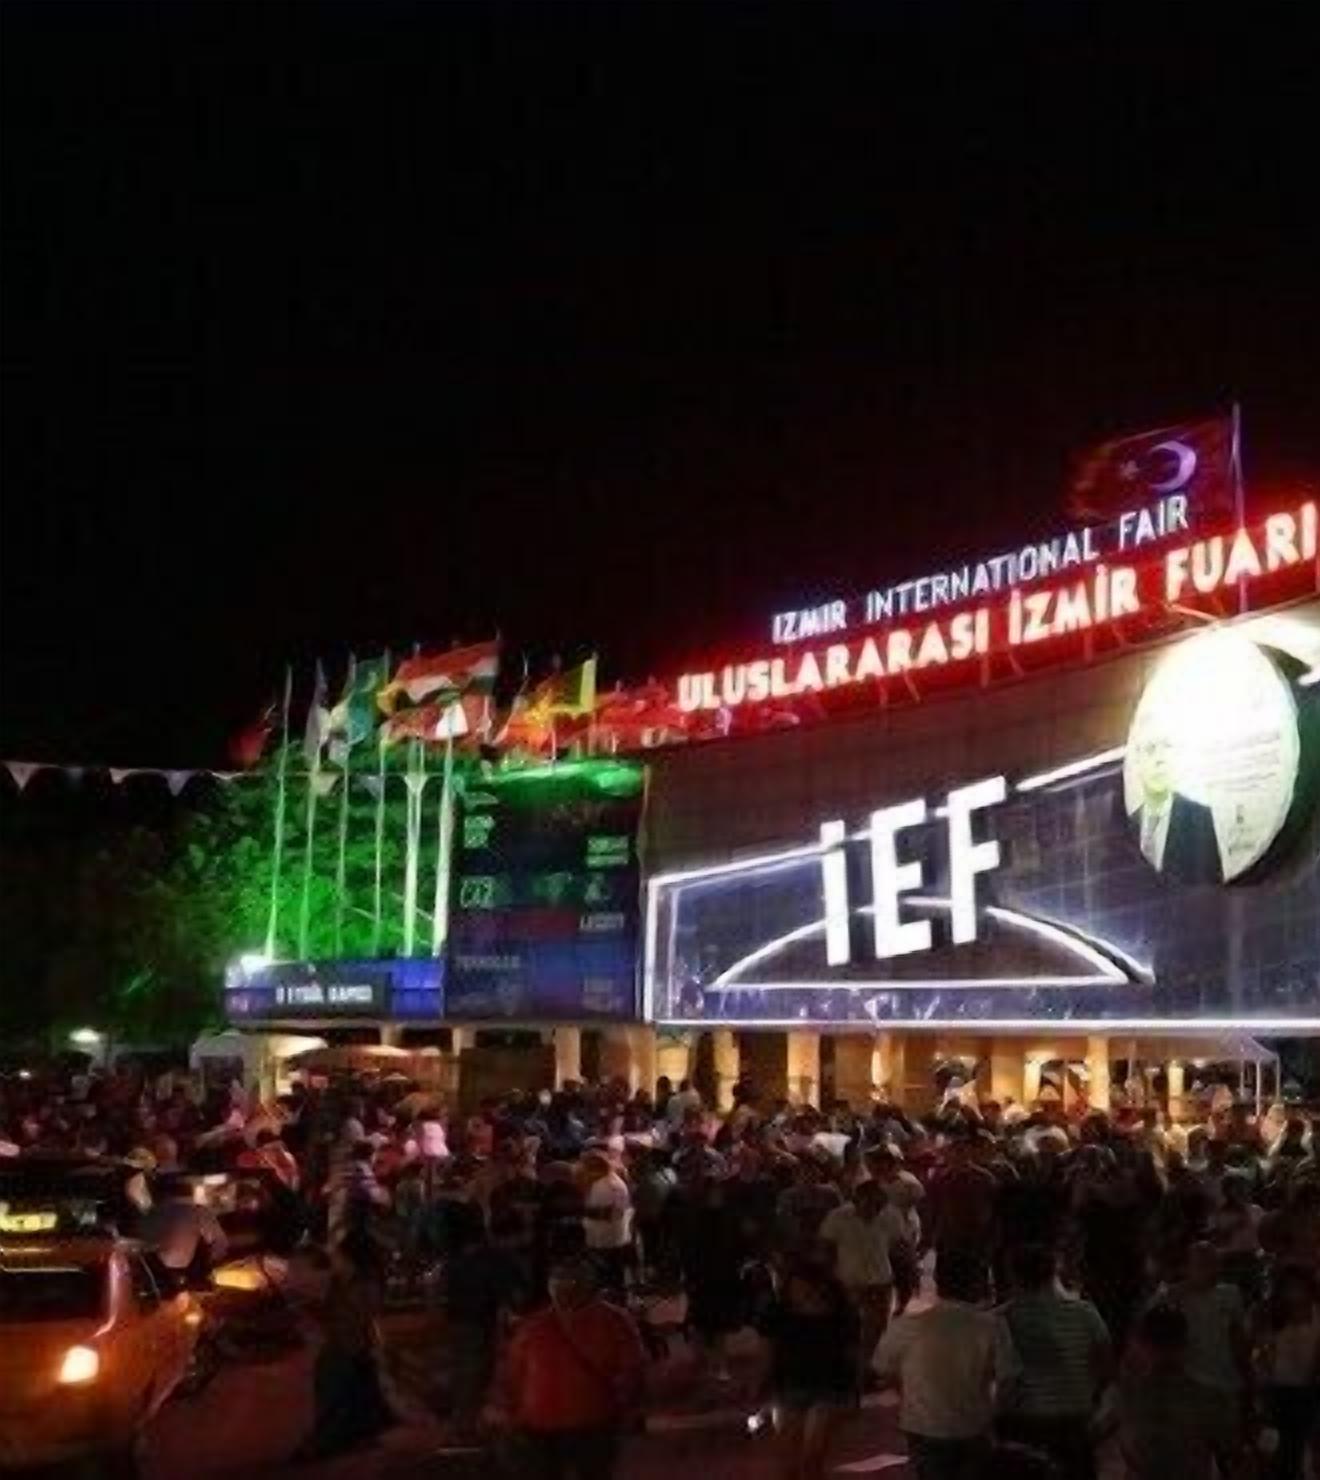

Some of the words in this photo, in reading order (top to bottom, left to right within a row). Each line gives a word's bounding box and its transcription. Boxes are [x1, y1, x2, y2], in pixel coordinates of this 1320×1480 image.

[677, 607, 990, 712] ULUSLARARASI
[1007, 563, 1141, 646] İZMİR
[1164, 501, 1318, 602] FUARI
[866, 526, 1099, 623] INTERNATIONAL
[1119, 494, 1189, 550] FAIR
